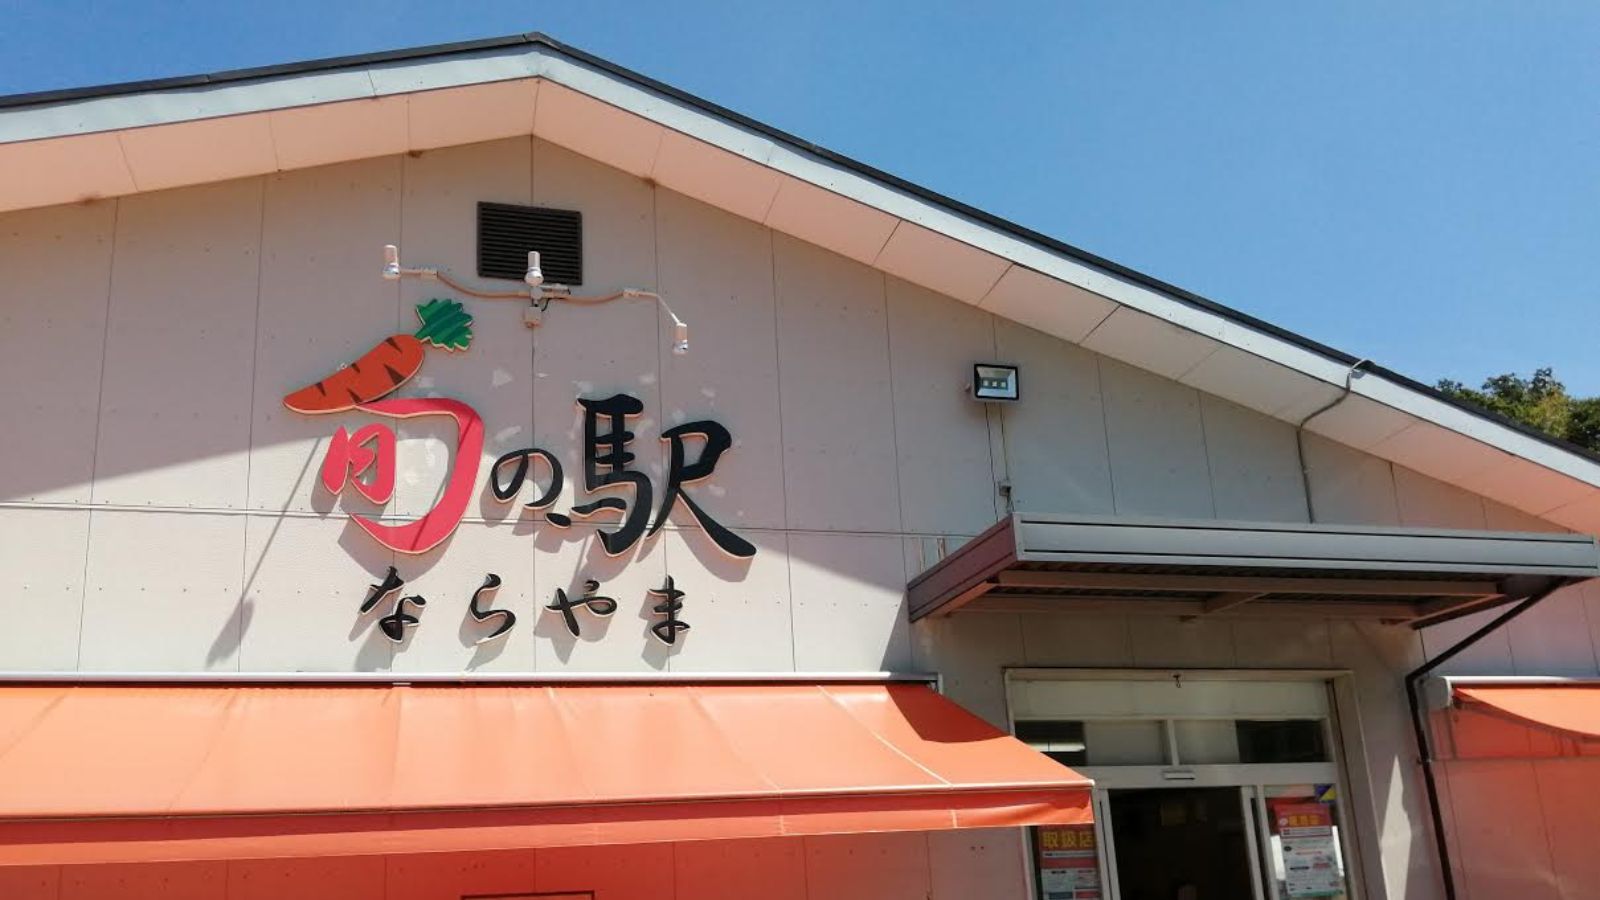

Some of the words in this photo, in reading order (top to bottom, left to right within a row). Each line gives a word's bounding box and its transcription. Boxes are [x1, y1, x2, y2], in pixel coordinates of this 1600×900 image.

[284, 334, 756, 557] 旬の駅
[361, 566, 690, 646] ならやま
[1042, 830, 1094, 849] 取扱店
